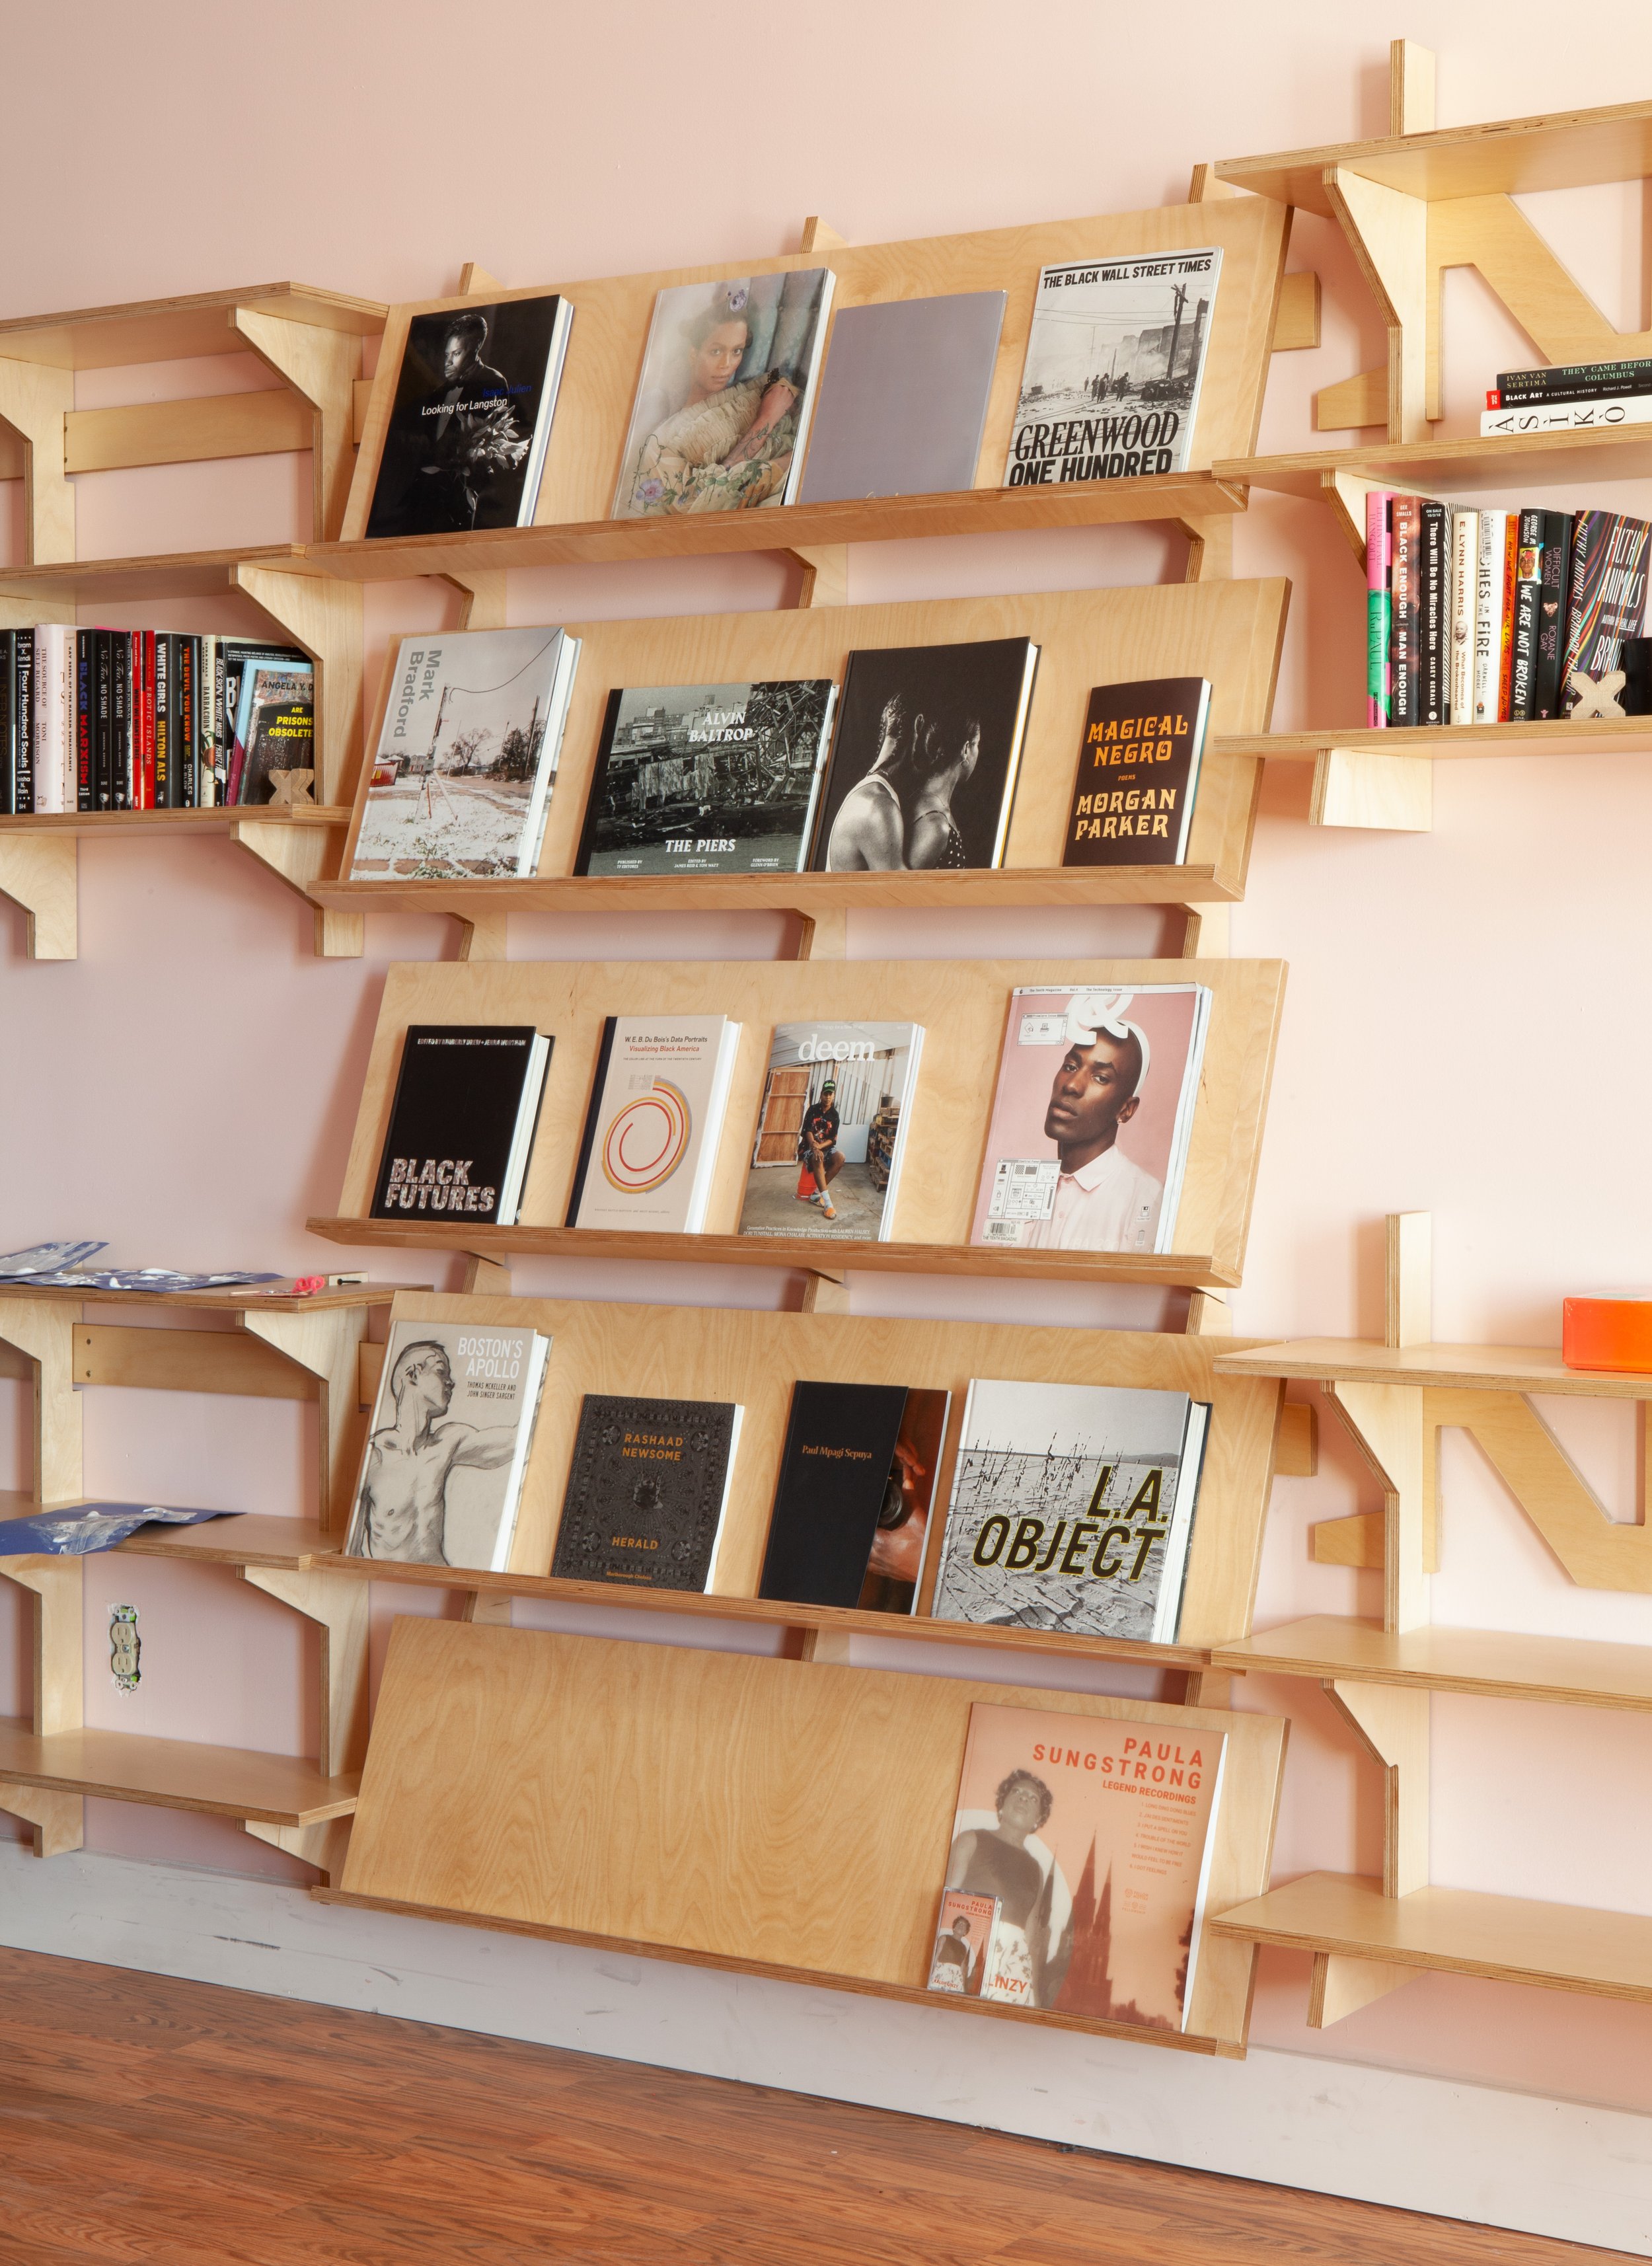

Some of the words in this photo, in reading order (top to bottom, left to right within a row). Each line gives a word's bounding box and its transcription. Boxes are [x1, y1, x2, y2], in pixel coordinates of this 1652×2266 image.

[1043, 274, 1063, 289] THE
[1065, 271, 1098, 286] BLACK
[1102, 268, 1129, 282] WALL
[1133, 262, 1176, 278] STREET
[1176, 259, 1211, 274] TIMES
[1562, 367, 1587, 375] THEY
[1591, 364, 1616, 373] CAME
[1621, 361, 1652, 370] BEFOR
[1585, 371, 1635, 381] COLUMBUS
[482, 387, 504, 398] Isaac
[506, 383, 532, 395] Julien
[1507, 379, 1546, 388] SERTIMA
[422, 403, 454, 416] Looking
[456, 401, 469, 410] for
[469, 398, 507, 412] Langston
[1015, 410, 1180, 461] GREENWOOD
[1008, 459, 1053, 486] ONE
[1060, 448, 1173, 483] HUNDRED
[1459, 521, 1465, 531] E.
[1576, 519, 1589, 558] FILTHY
[1606, 526, 1649, 566] FILTHY
[1430, 567, 1438, 577] Be
[1507, 561, 1512, 572] WE
[1544, 550, 1552, 585] WOMEN
[1551, 547, 1561, 589] DIFFICULT
[1573, 558, 1586, 601] ANIMALS
[1399, 568, 1408, 619] ENOUGH
[1430, 580, 1438, 590] No
[1521, 584, 1533, 602] WE
[1597, 567, 1645, 609] ANIMALS
[1429, 593, 1438, 629] Miracles
[1519, 605, 1532, 628] ARE
[1517, 630, 1530, 657] NOT
[1547, 625, 1557, 660] ROXANE
[157, 643, 166, 680] WHITE
[262, 681, 296, 690] ANGELA
[419, 650, 443, 701] Mark
[1514, 659, 1528, 705] BROKEN
[42, 697, 47, 708] OF
[100, 685, 107, 694] NO
[157, 681, 166, 713] GIRLS
[393, 651, 424, 737] Bradford
[1398, 664, 1407, 715] ENOUGH
[268, 728, 313, 737] OBSOLETE
[276, 716, 313, 726] PRISONS
[701, 712, 747, 726] ALVIN
[1087, 714, 1188, 743] MAGICAL
[157, 720, 166, 759] HILTON
[689, 728, 754, 742] BALTROP
[80, 714, 89, 784] MARXISM
[1094, 740, 1172, 767] NEGRO
[157, 761, 166, 781] ALS
[1076, 788, 1177, 815] MORGAN
[1074, 814, 1168, 841] PARKER
[665, 840, 693, 852] THE
[696, 839, 736, 852] PIERS
[798, 1034, 875, 1061] deem
[389, 1158, 473, 1186] BLACK
[385, 1184, 496, 1212] FUTURES
[457, 1337, 523, 1359] BOSTON'S
[465, 1357, 519, 1378] APOLLO
[624, 1433, 683, 1447] RASHAAD
[802, 1445, 819, 1454] Paul
[819, 1446, 844, 1458] Mpagi
[845, 1448, 872, 1460] Sepuya
[622, 1447, 681, 1461] NEWSOME
[1086, 1465, 1169, 1524] L.A.
[612, 1536, 659, 1550] HERALD
[973, 1515, 1166, 1581] OBJECT
[1123, 1737, 1203, 1768] PAULA
[1032, 1744, 1202, 1790] SUNGSTRONG
[1102, 1780, 1137, 1795] LEGEND
[1139, 1787, 1197, 1805] RECORDINGS
[948, 1901, 992, 1915] SUNGSTRONG
[971, 1901, 993, 1910] PAULA
